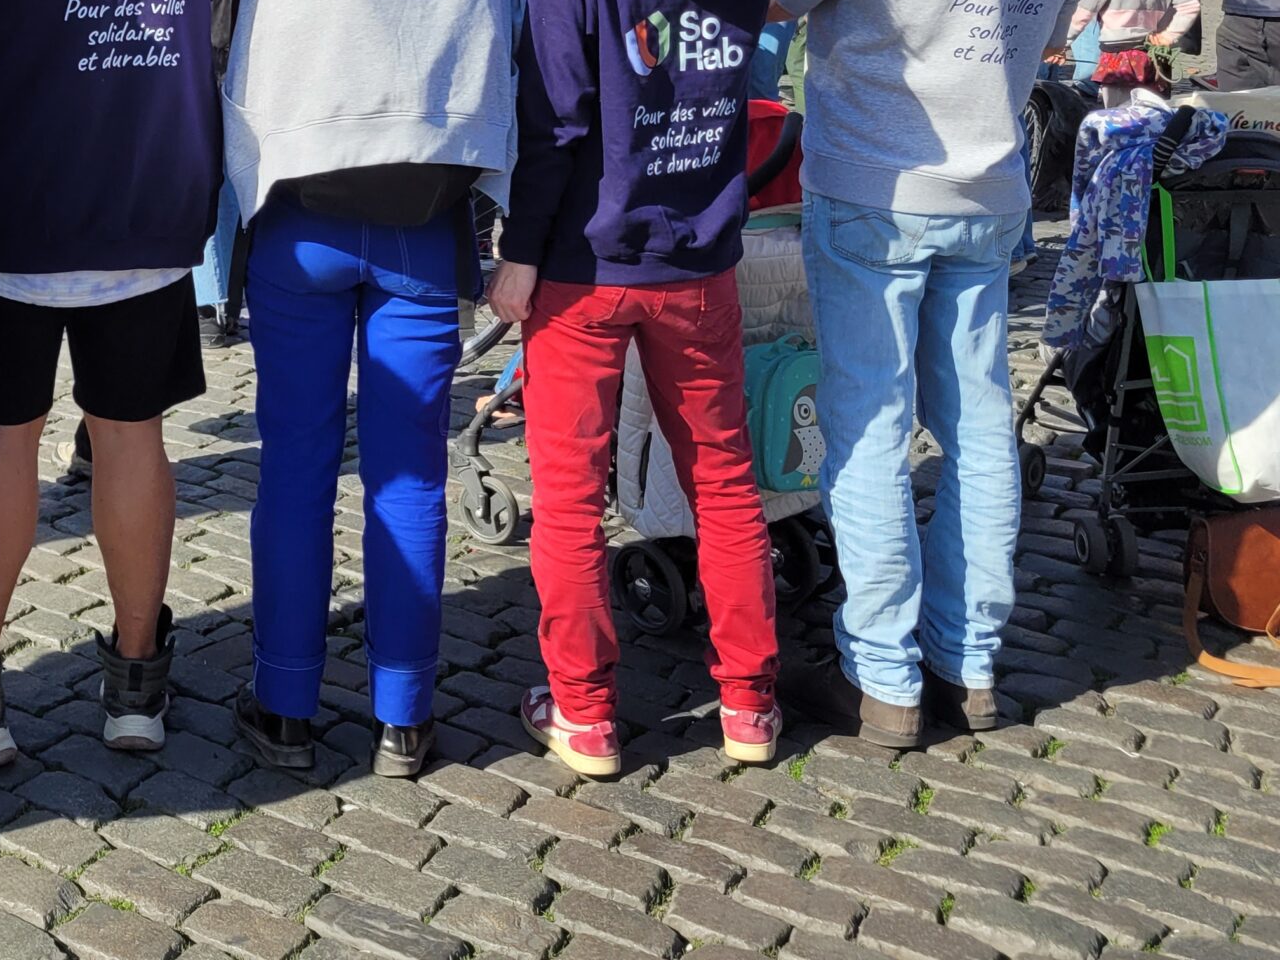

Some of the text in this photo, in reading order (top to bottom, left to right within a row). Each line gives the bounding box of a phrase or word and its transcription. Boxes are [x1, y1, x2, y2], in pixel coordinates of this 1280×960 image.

[88, 21, 174, 46] solidaires
[679, 10, 720, 42] So
[78, 46, 180, 71] et durables
[679, 36, 744, 71] Hab
[953, 46, 975, 60] et
[634, 97, 737, 128] Pour des villes
[651, 126, 723, 151] solidaires
[647, 157, 662, 176] et
